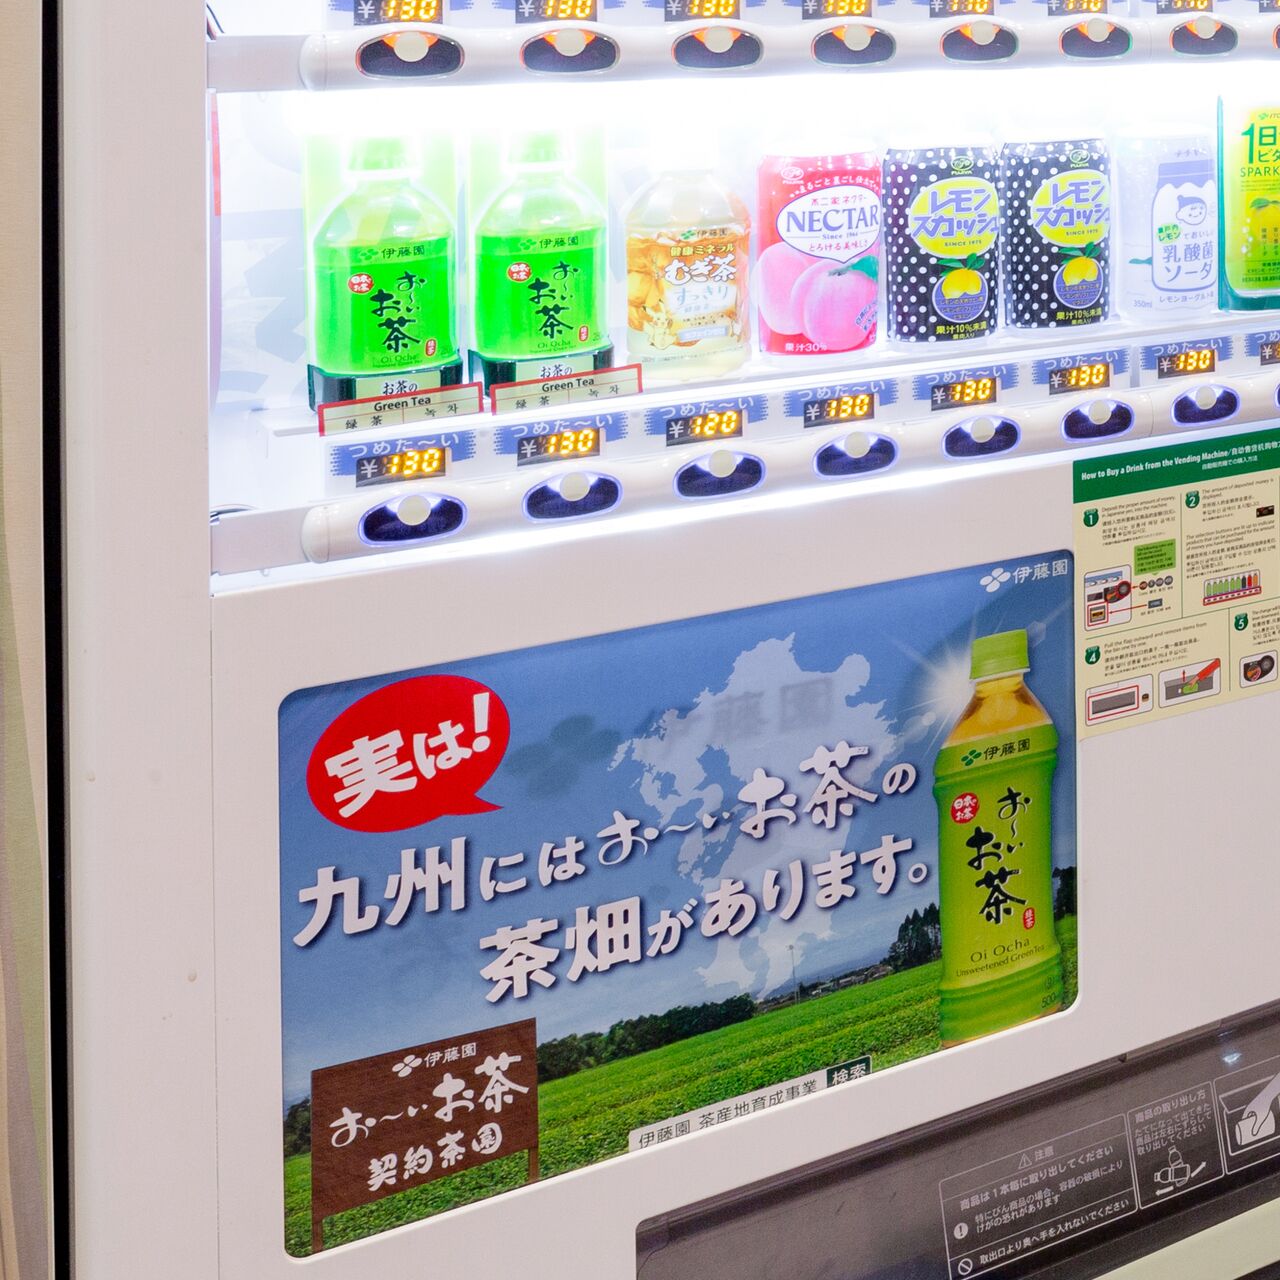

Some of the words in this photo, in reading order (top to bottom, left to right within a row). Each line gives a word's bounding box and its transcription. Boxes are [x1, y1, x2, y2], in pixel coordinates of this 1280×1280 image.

[931, 188, 991, 214] レモン
[1052, 181, 1105, 205] レモン
[786, 205, 879, 233] NECTAR
[1162, 242, 1214, 262] 乳酸菌
[1163, 262, 1214, 283] ソーダ
[382, 381, 418, 397] お茶の
[374, 399, 408, 413] Green
[410, 396, 431, 408] Tea
[1082, 471, 1096, 480] How
[1098, 470, 1105, 478] to
[1106, 468, 1119, 479] Buy
[1126, 462, 1143, 473] Drink
[1144, 460, 1160, 470] from
[1162, 457, 1173, 466] the
[1174, 452, 1200, 466] Vending
[324, 692, 492, 819] 実は!
[479, 832, 930, 1004] 茶畑があります。
[831, 1063, 868, 1086] 検索
[638, 1120, 691, 1150] 伊藤園
[698, 1079, 818, 1129] 茶産地育成事業
[1135, 1090, 1206, 1122] 商品の取り出し方
[1135, 1102, 1211, 1137] たてになって出てきた
[1136, 1113, 1212, 1147] 商品は左右にずらして
[1136, 1124, 1207, 1156] 取り出してください
[367, 1121, 503, 1192] 契約茶園
[976, 1194, 1061, 1233] けがの恐れがあります
